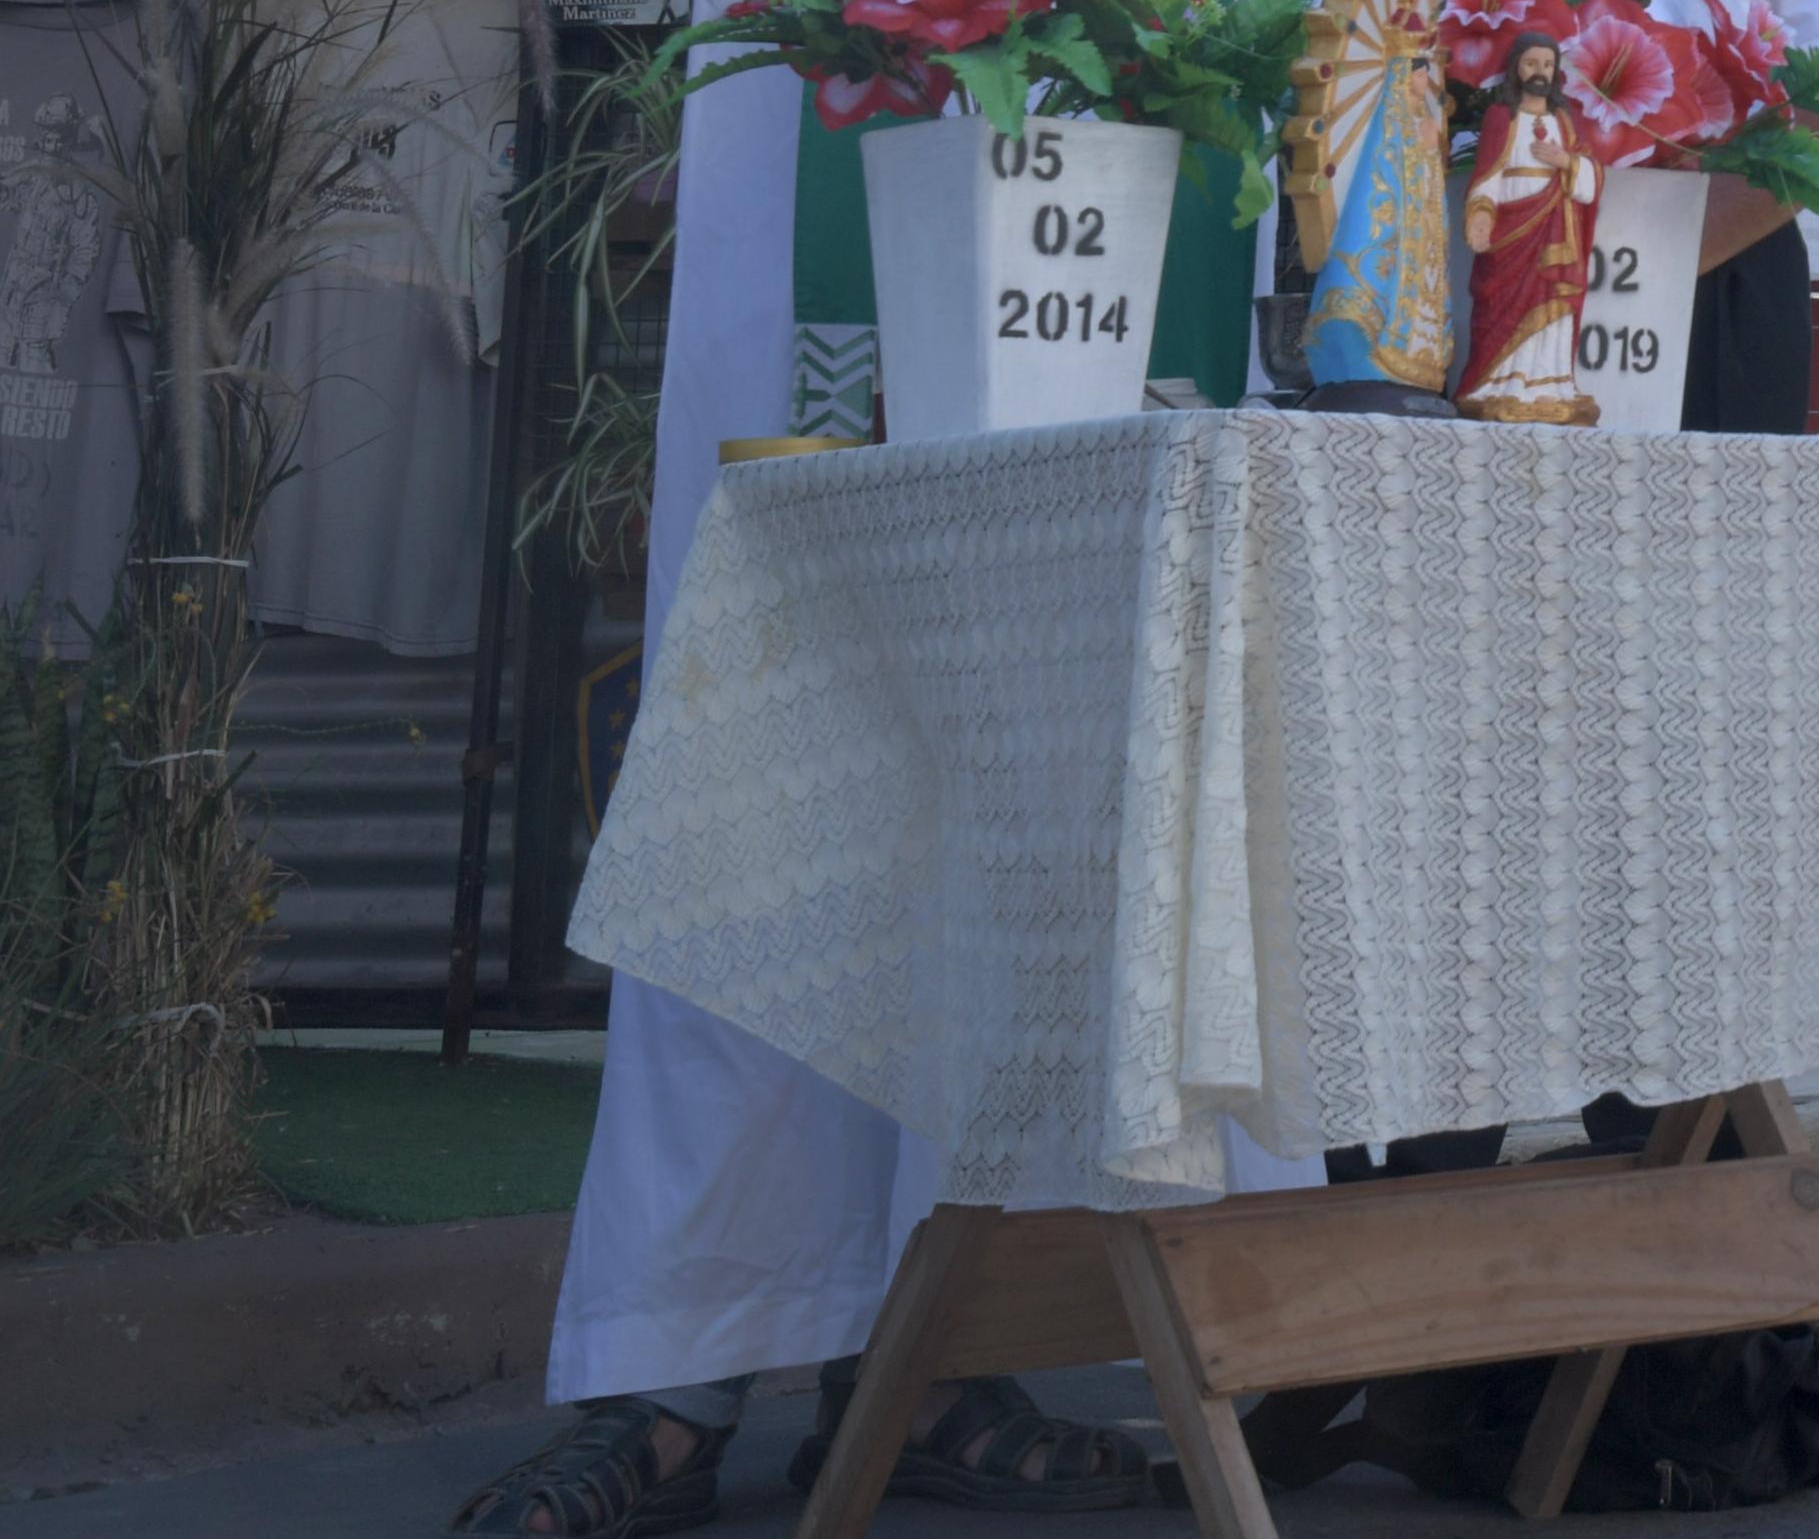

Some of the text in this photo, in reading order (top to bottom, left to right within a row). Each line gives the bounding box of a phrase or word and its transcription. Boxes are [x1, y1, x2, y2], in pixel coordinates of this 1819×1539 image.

[991, 131, 1064, 182] 05
[1032, 204, 1106, 257] 02
[997, 288, 1131, 344] 2014
